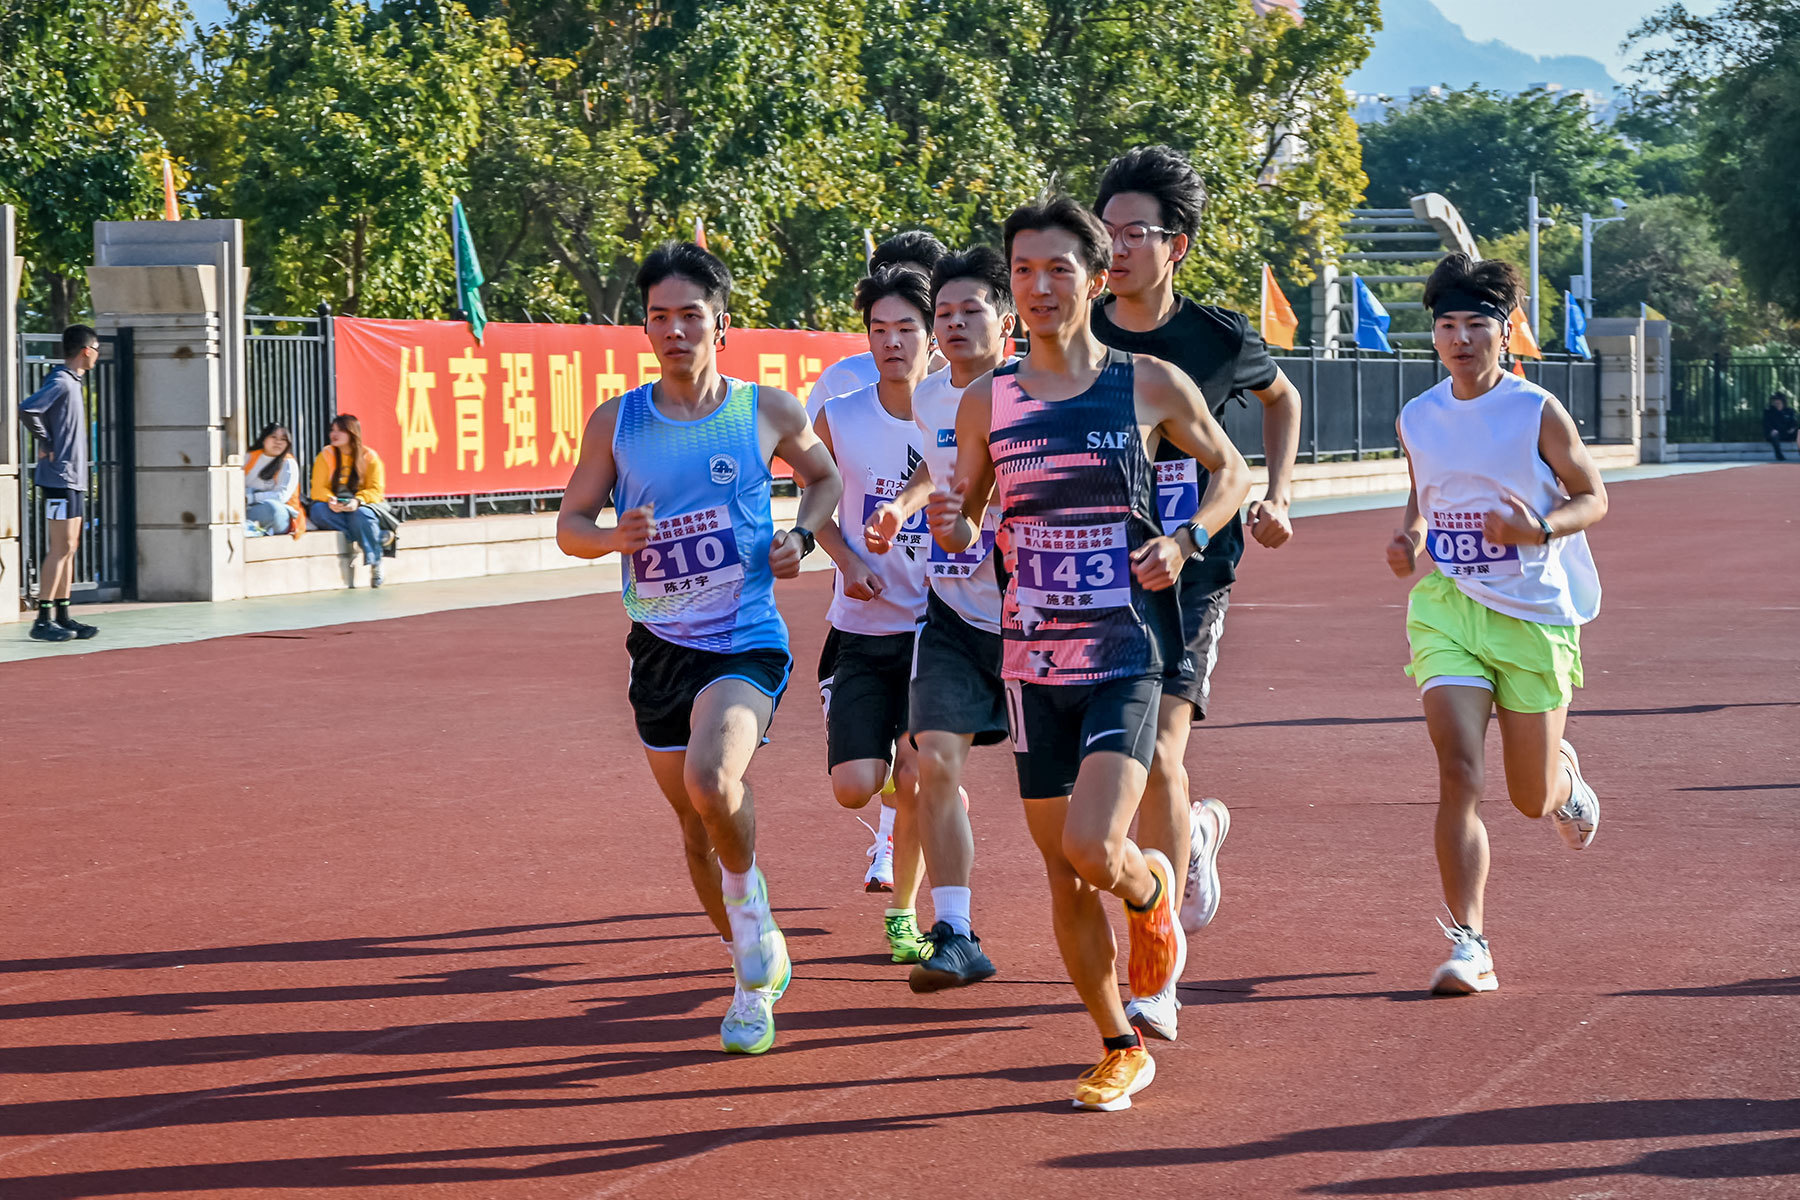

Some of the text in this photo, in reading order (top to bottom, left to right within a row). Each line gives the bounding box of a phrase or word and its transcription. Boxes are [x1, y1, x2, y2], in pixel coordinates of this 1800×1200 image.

[938, 433, 956, 443] LI-
[50, 502, 61, 520] 7
[1159, 487, 1184, 517] 7
[1023, 526, 1113, 540] 厦门大学嘉庚学院
[1025, 537, 1113, 549] 第八届田径运动会
[1434, 532, 1507, 562] 086
[641, 536, 725, 579] 210
[1028, 553, 1115, 589] 143
[663, 575, 710, 593] 陈才宇
[1046, 593, 1094, 606] 施君豪
